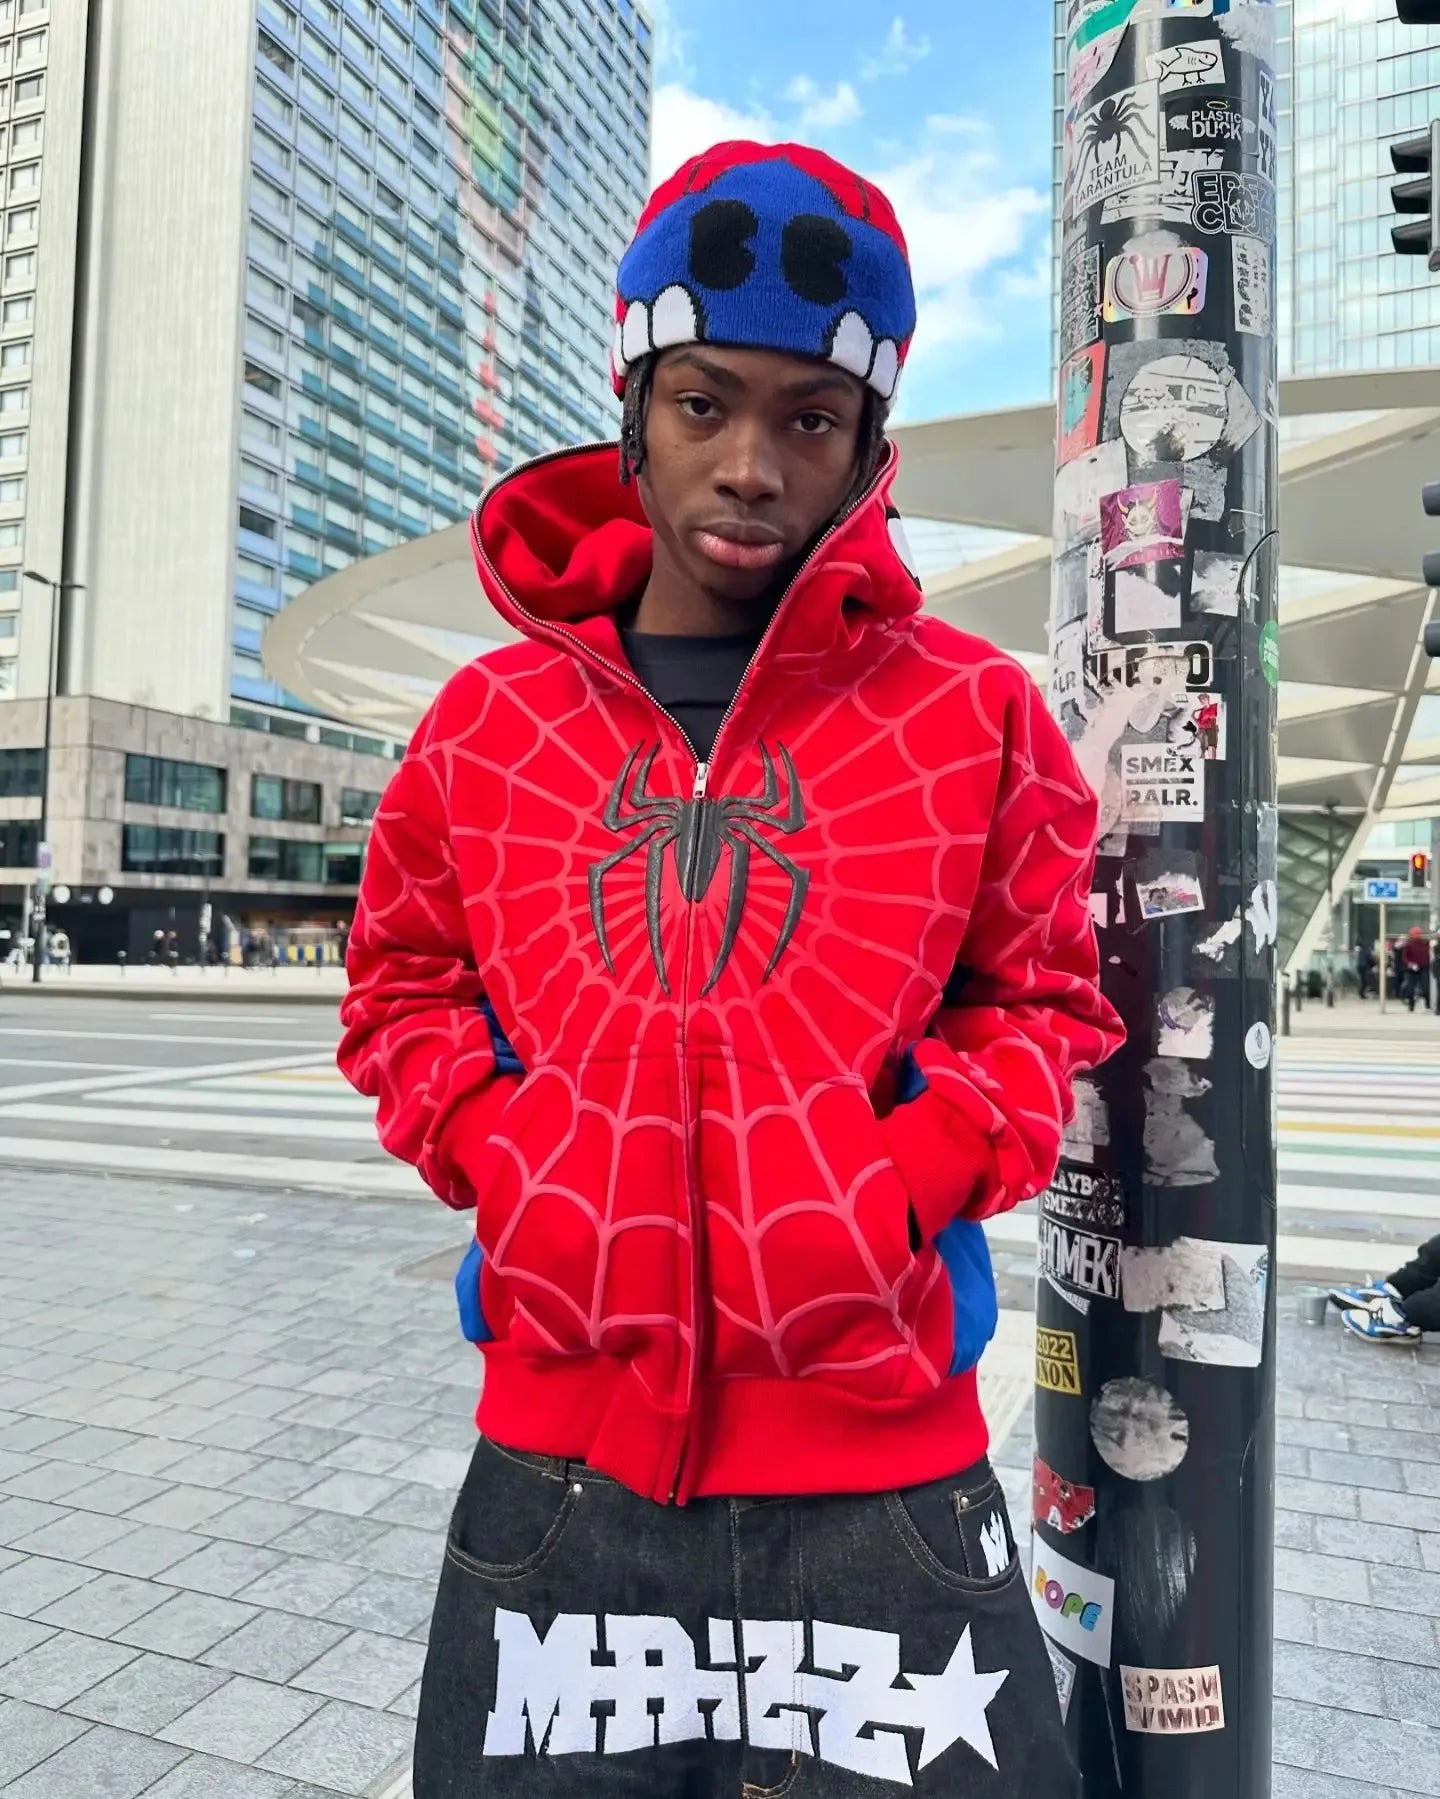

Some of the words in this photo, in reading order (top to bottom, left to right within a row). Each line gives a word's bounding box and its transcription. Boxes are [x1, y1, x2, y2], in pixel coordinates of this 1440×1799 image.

[1191, 110, 1242, 123] PLASTIC
[1191, 121, 1242, 141] DUCK
[1090, 153, 1128, 180] TEAM
[1126, 756, 1195, 774] SMEX
[1037, 1333, 1072, 1359] 2022
[1124, 1674, 1219, 1704] SPASM
